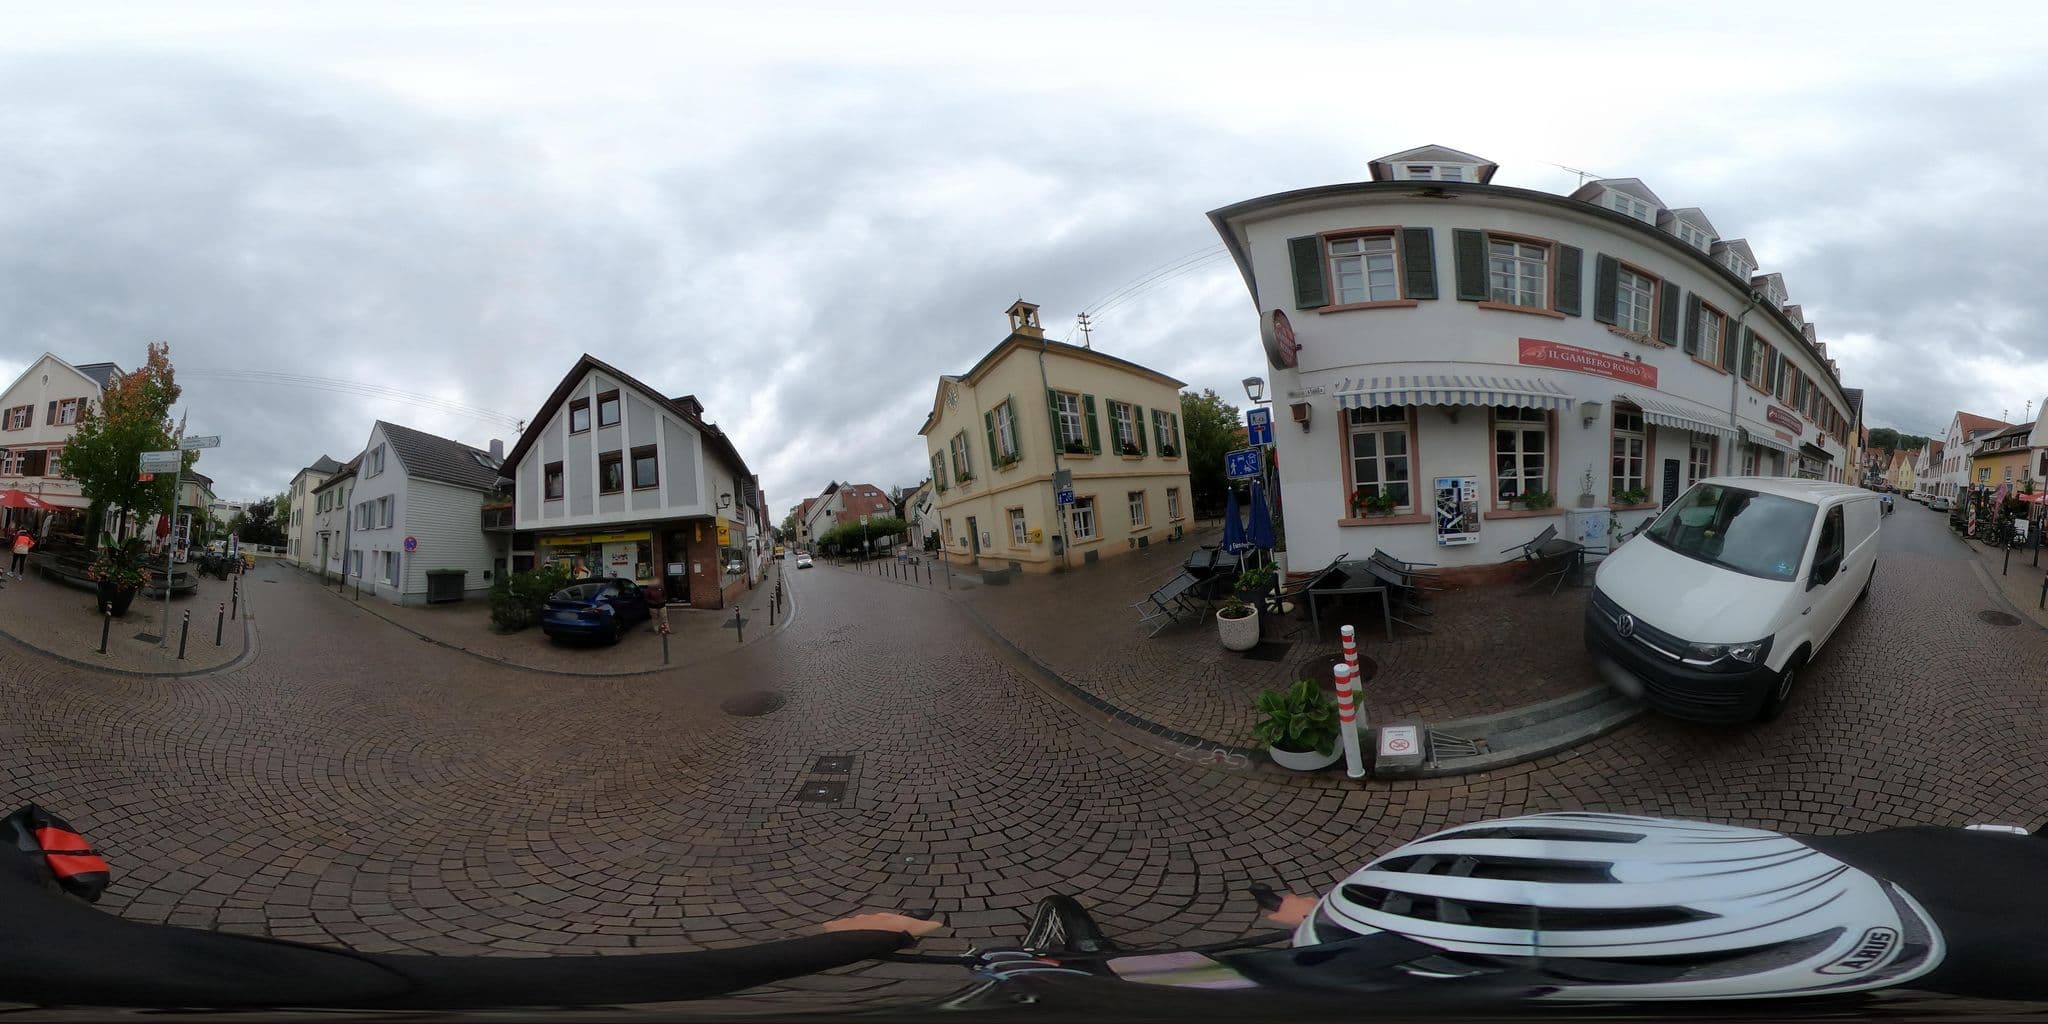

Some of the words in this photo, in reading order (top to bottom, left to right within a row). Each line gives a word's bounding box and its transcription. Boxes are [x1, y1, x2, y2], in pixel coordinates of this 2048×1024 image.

[1549, 350, 1559, 360] IL
[1561, 352, 1611, 368] GAMBERO
[1612, 363, 1641, 376] ROSSO
[1838, 933, 1891, 969] ABUS
